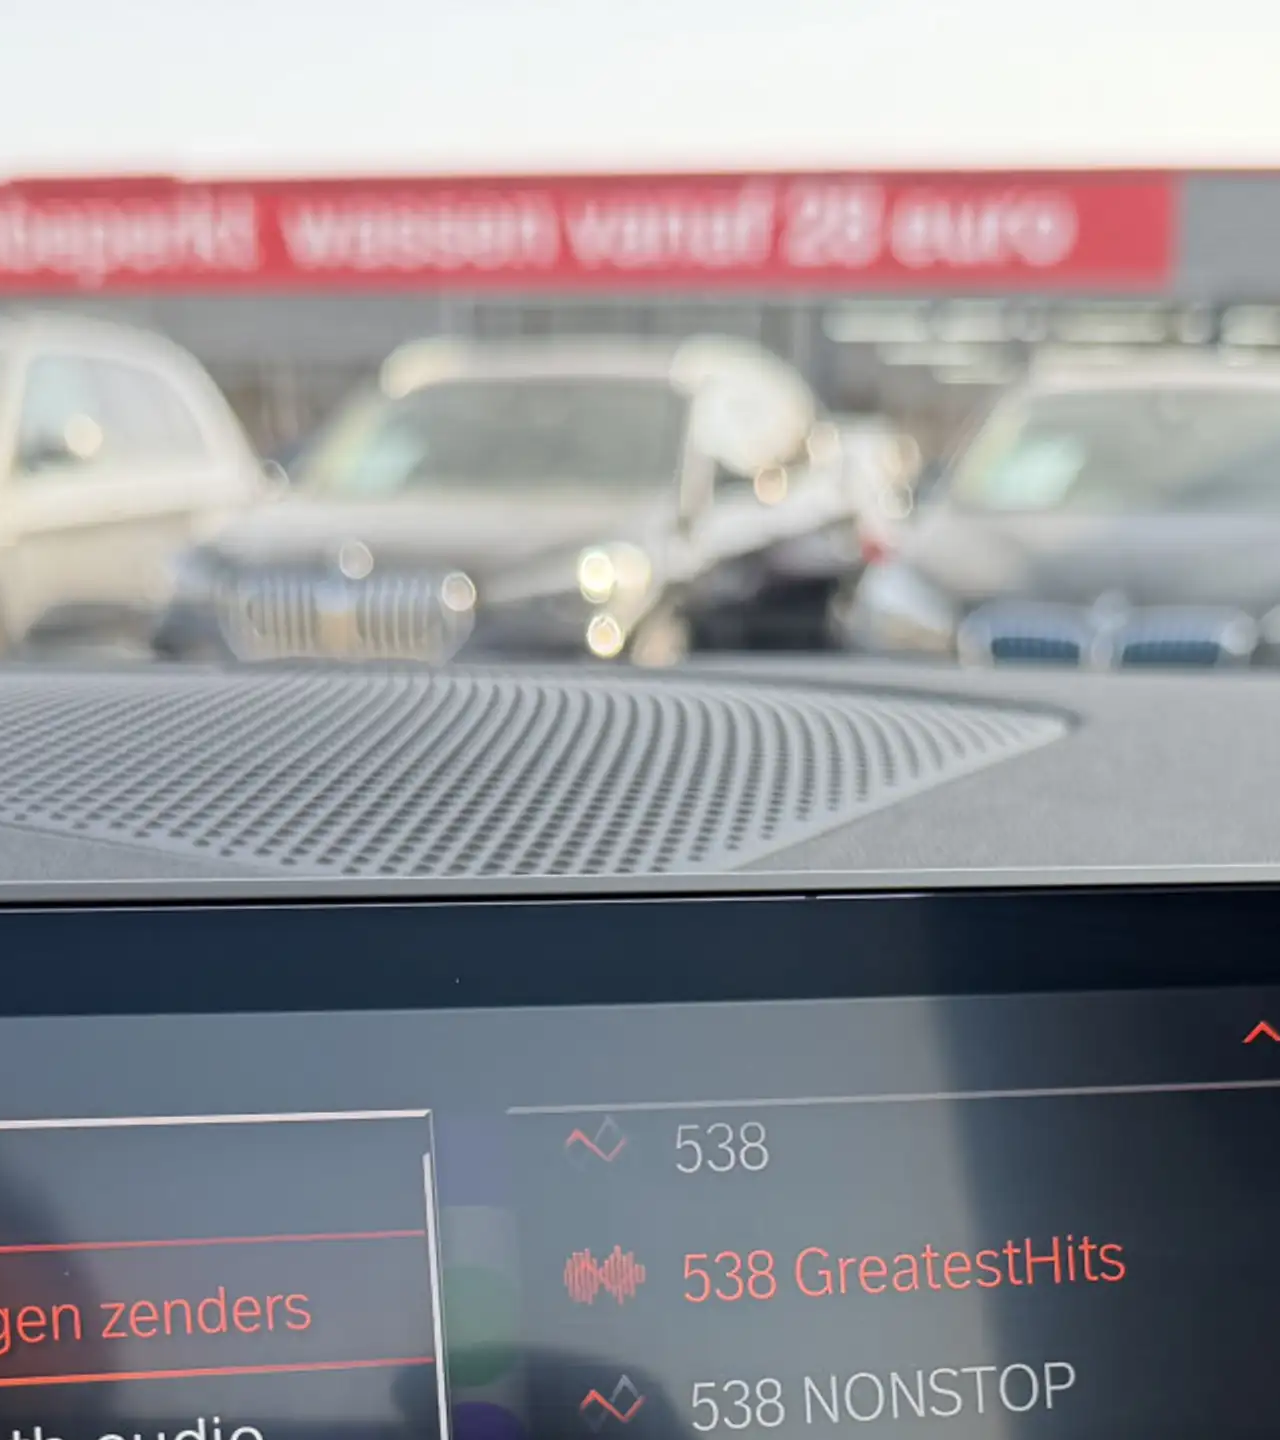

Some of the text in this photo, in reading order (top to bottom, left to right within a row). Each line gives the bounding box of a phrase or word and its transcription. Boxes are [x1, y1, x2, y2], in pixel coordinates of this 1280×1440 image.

[278, 204, 558, 271] wassen
[566, 188, 774, 270] vanaf
[890, 197, 1077, 269] euro
[677, 1123, 768, 1173] 538
[685, 1237, 1126, 1302] 538 GreatestHits
[102, 1288, 311, 1339] zenders
[693, 1362, 1075, 1431] 538 NONSTOP
